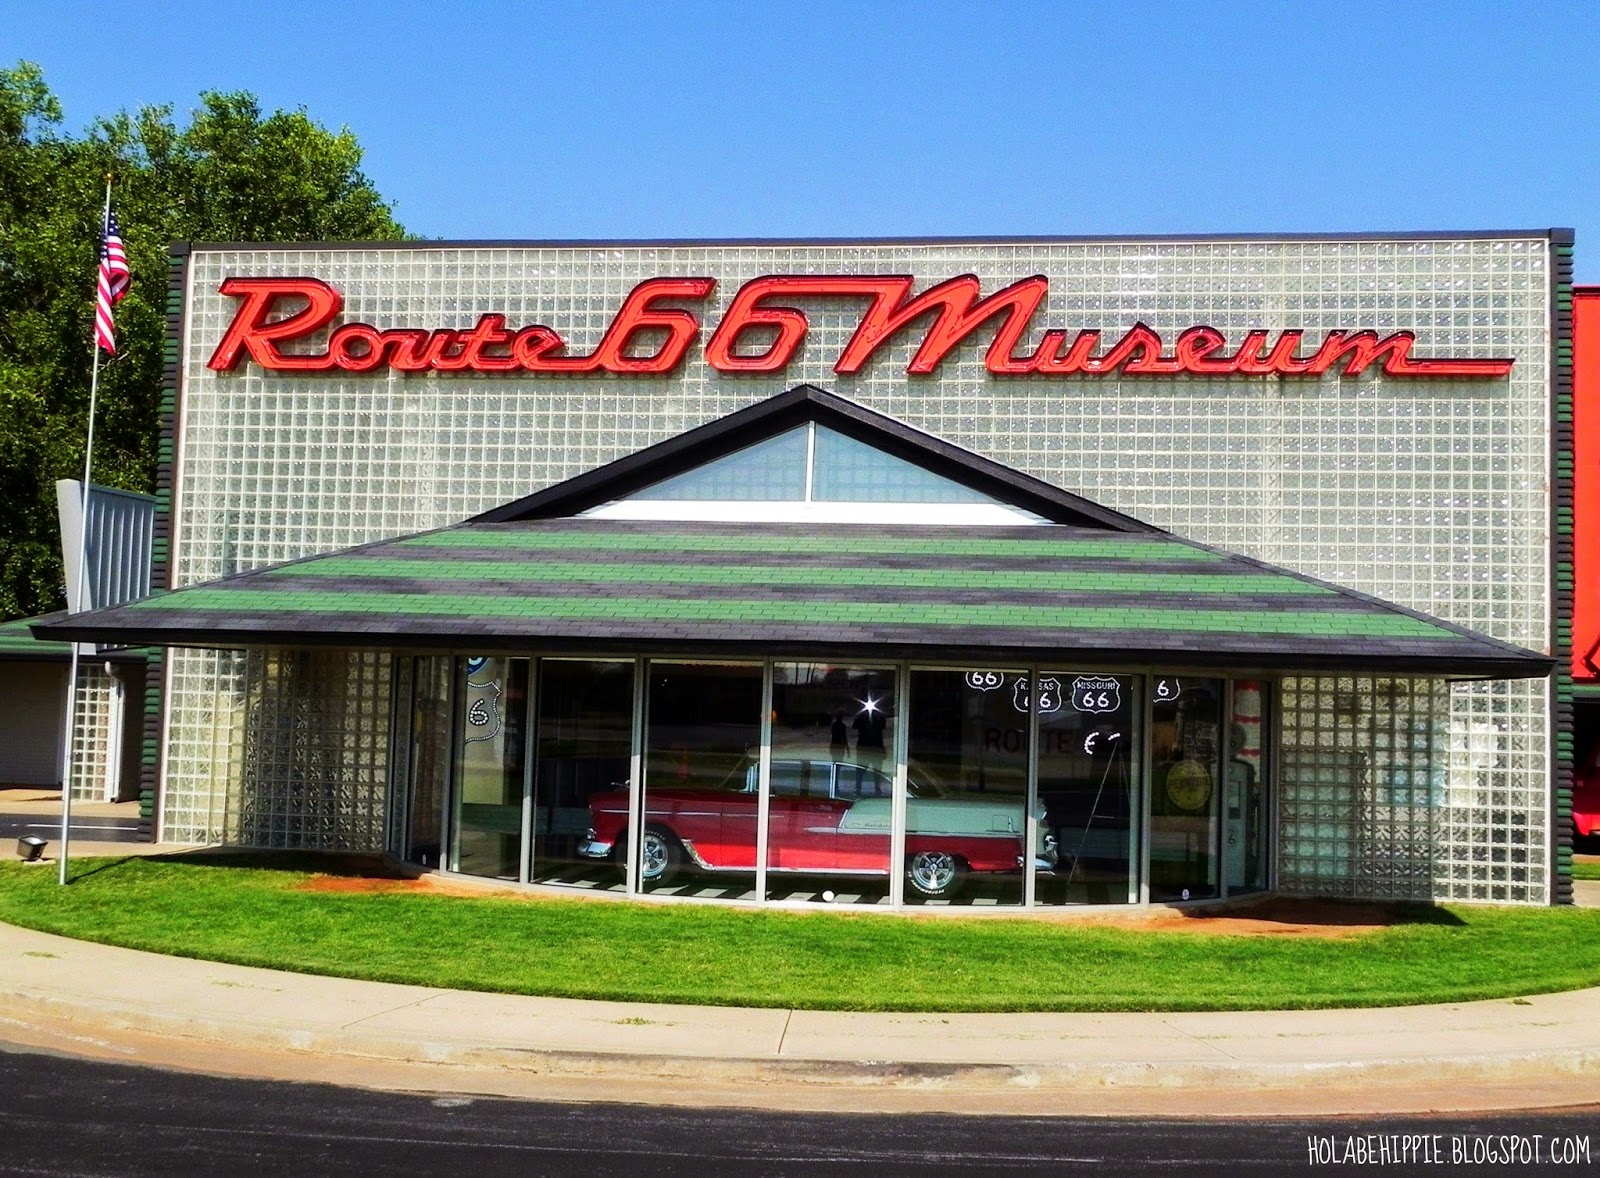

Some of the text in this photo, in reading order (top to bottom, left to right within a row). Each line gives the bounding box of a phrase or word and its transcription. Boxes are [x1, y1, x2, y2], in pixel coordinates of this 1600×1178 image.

[206, 273, 1514, 376] Route 66 Museum
[971, 672, 998, 686] 66
[1020, 682, 1054, 691] KSAS
[1077, 681, 1116, 691] MISSOURI
[1082, 691, 1110, 708] 66
[986, 728, 1071, 752] ROTE
